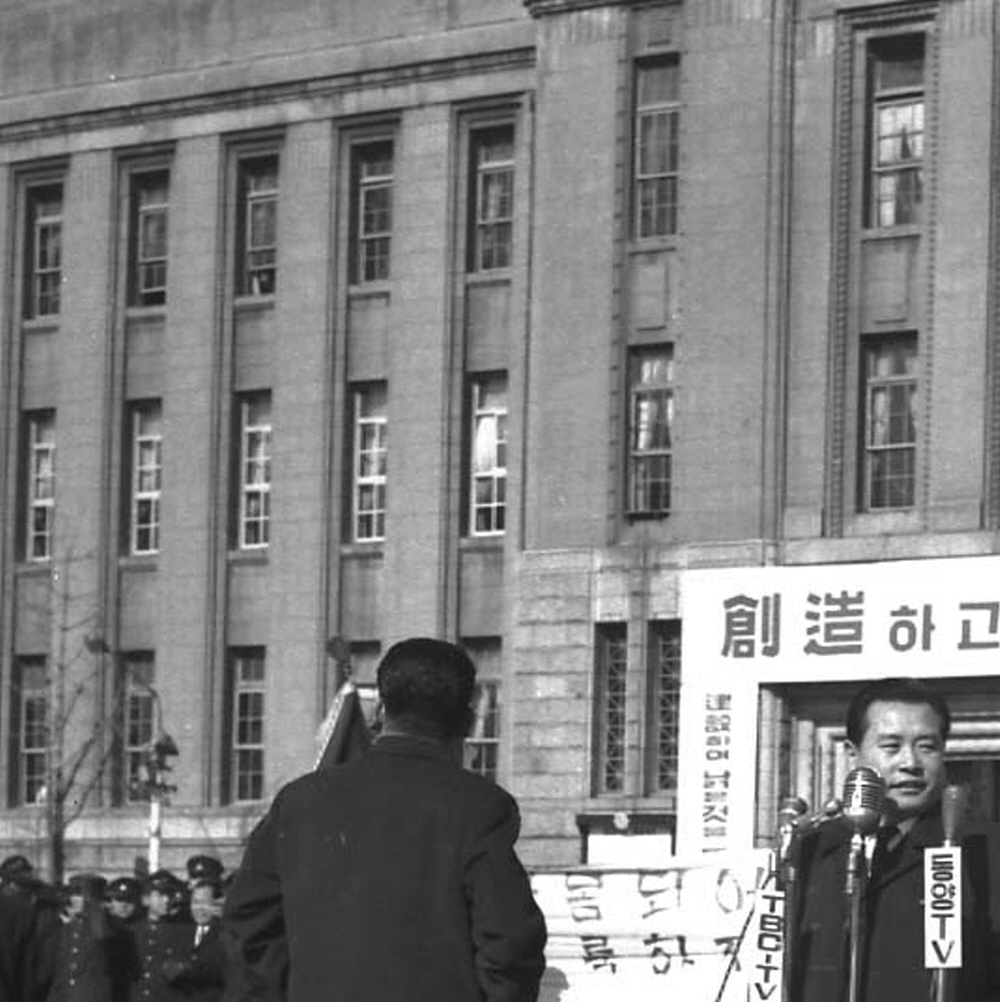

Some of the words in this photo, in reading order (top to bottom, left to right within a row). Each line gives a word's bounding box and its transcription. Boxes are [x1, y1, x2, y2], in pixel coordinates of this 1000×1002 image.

[721, 590, 1000, 658] 創造하고
[754, 895, 785, 1001] TBC-TV
[930, 853, 956, 964] 동양TV
